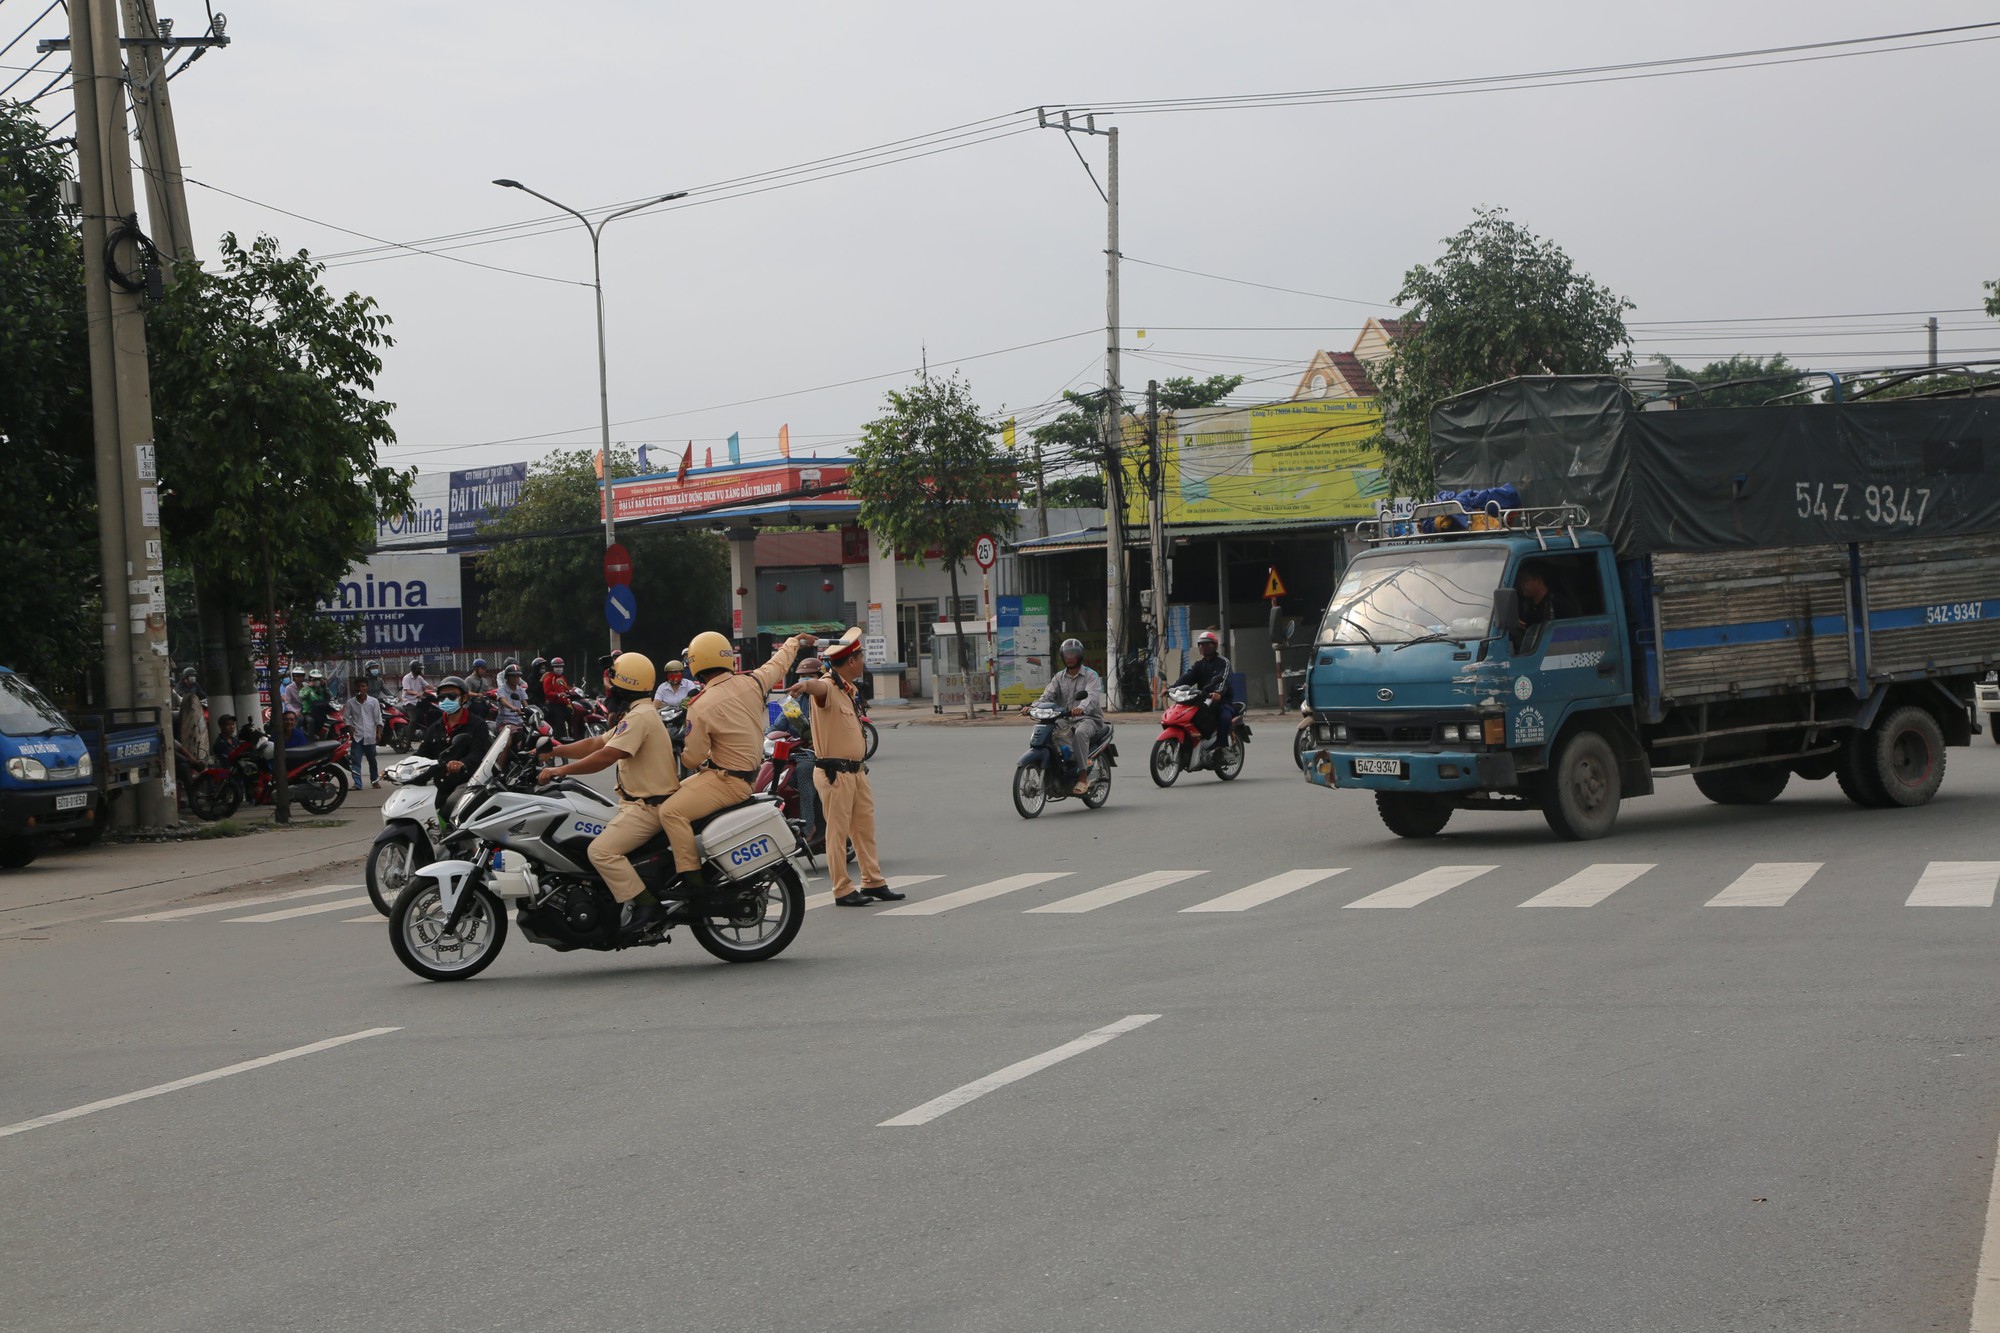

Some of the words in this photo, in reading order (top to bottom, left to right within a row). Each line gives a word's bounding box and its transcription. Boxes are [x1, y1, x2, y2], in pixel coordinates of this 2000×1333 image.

[451, 487, 469, 517] ĐẠI
[472, 478, 500, 511] TUẤN
[325, 574, 428, 609] mina
[378, 612, 404, 620] THÉP
[1926, 602, 1982, 623] 54Z-9347
[375, 624, 424, 644] HUY
[1358, 760, 1398, 773] 54Z-9347
[574, 821, 606, 835] CSG
[730, 838, 770, 866] CSGT
